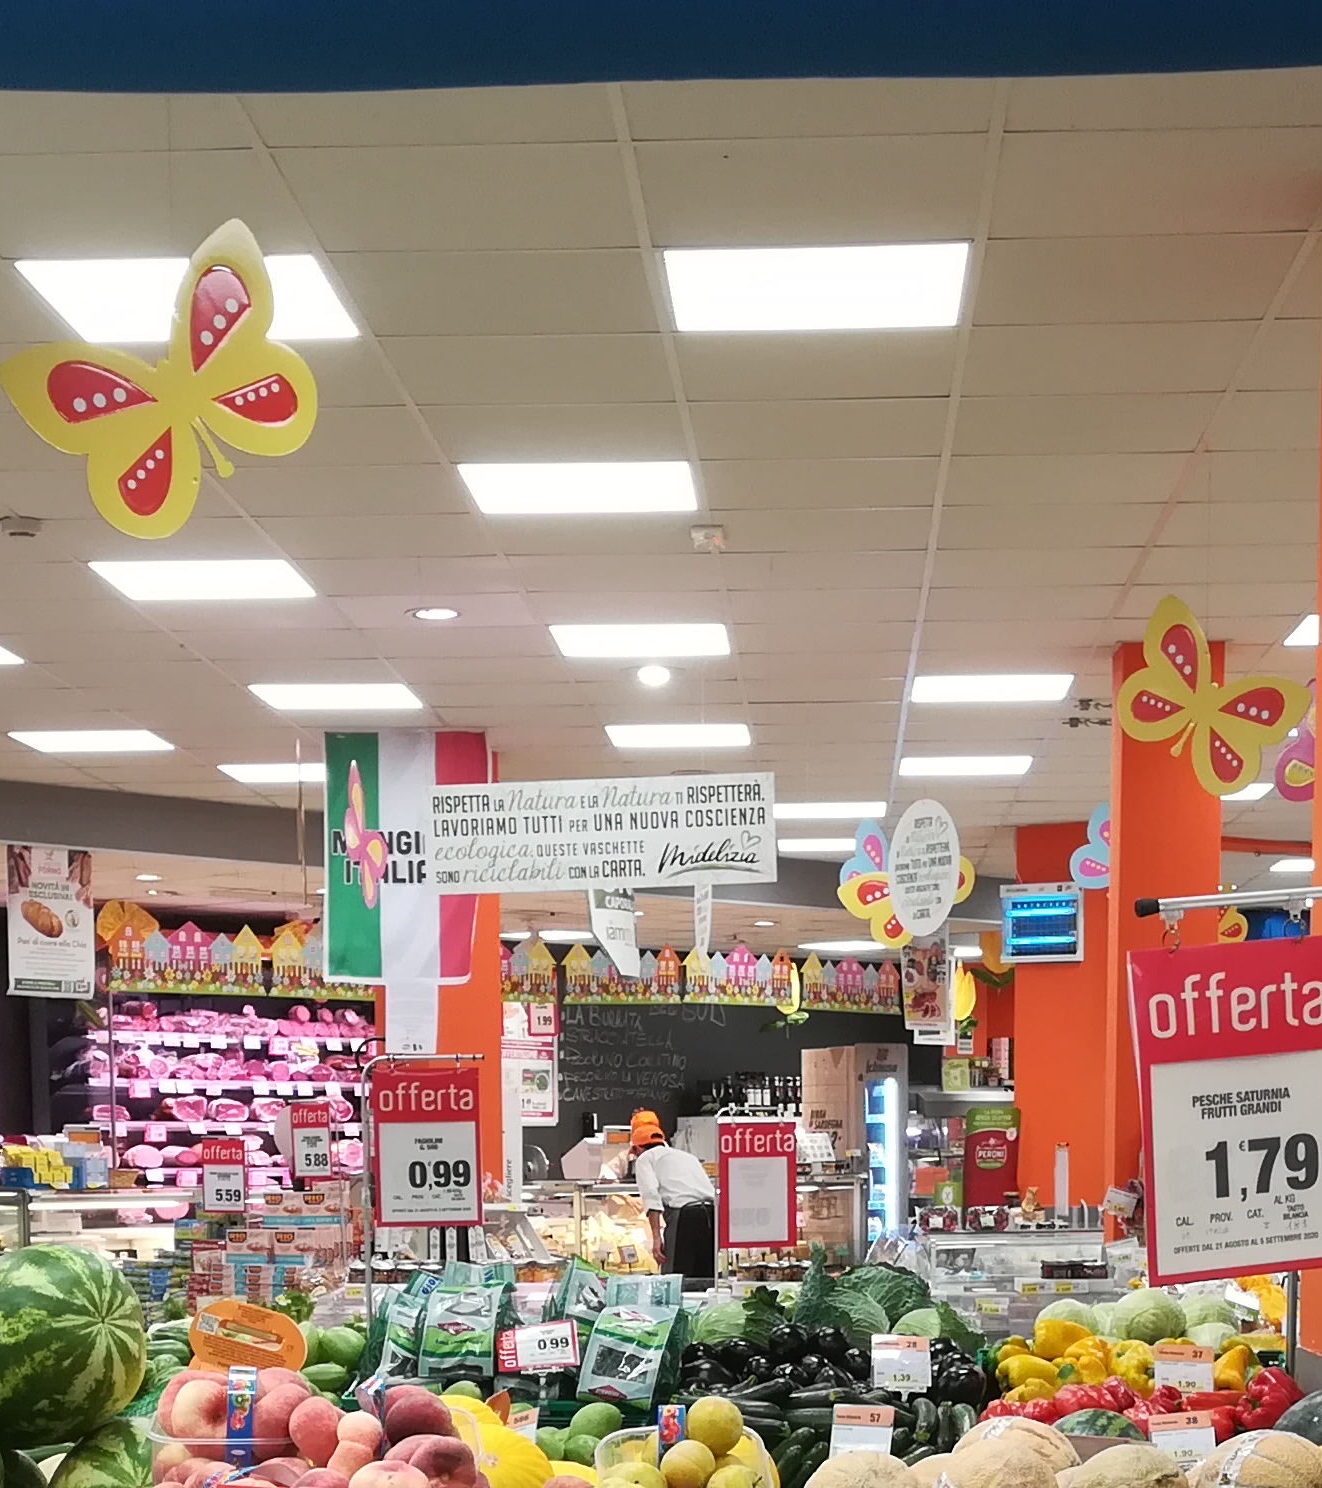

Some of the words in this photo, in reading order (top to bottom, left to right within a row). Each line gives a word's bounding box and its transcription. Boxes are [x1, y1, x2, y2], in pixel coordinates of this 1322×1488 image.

[432, 794, 490, 814] RISPETTA
[493, 798, 505, 813] LA
[508, 785, 579, 813] Natura
[602, 782, 672, 809] Natura
[433, 815, 517, 838] LAVORIAMO
[523, 815, 563, 834] TUTTI
[569, 818, 589, 833] PER
[594, 812, 623, 832] UNA
[629, 810, 680, 831] NUOVA
[685, 806, 766, 829] COSCIENZA
[536, 842, 578, 858] QUESTE
[582, 840, 645, 856] VASCHETTE
[435, 871, 460, 884] SONO
[463, 857, 563, 884] riciclabili
[568, 866, 587, 879] CON
[588, 865, 600, 879] LA
[602, 858, 646, 878] CARTA.
[379, 1081, 474, 1112] offerta
[1192, 1092, 1233, 1108] PESCHE
[1236, 1086, 1290, 1104] SATURNIA
[291, 1109, 328, 1125] offerta
[1201, 1105, 1237, 1120] FRUTTI
[1240, 1100, 1282, 1116] GRANDI
[720, 1127, 795, 1154] offerta
[202, 1145, 243, 1161] offerta
[977, 1149, 1005, 1159] PERONI
[408, 1159, 471, 1191] 0,99
[1209, 1211, 1233, 1224] PROV.
[1266, 1233, 1302, 1246] SETTEMBRE
[1192, 1350, 1203, 1359] 37
[869, 1413, 881, 1423] 57
[1185, 1416, 1199, 1425] 38
